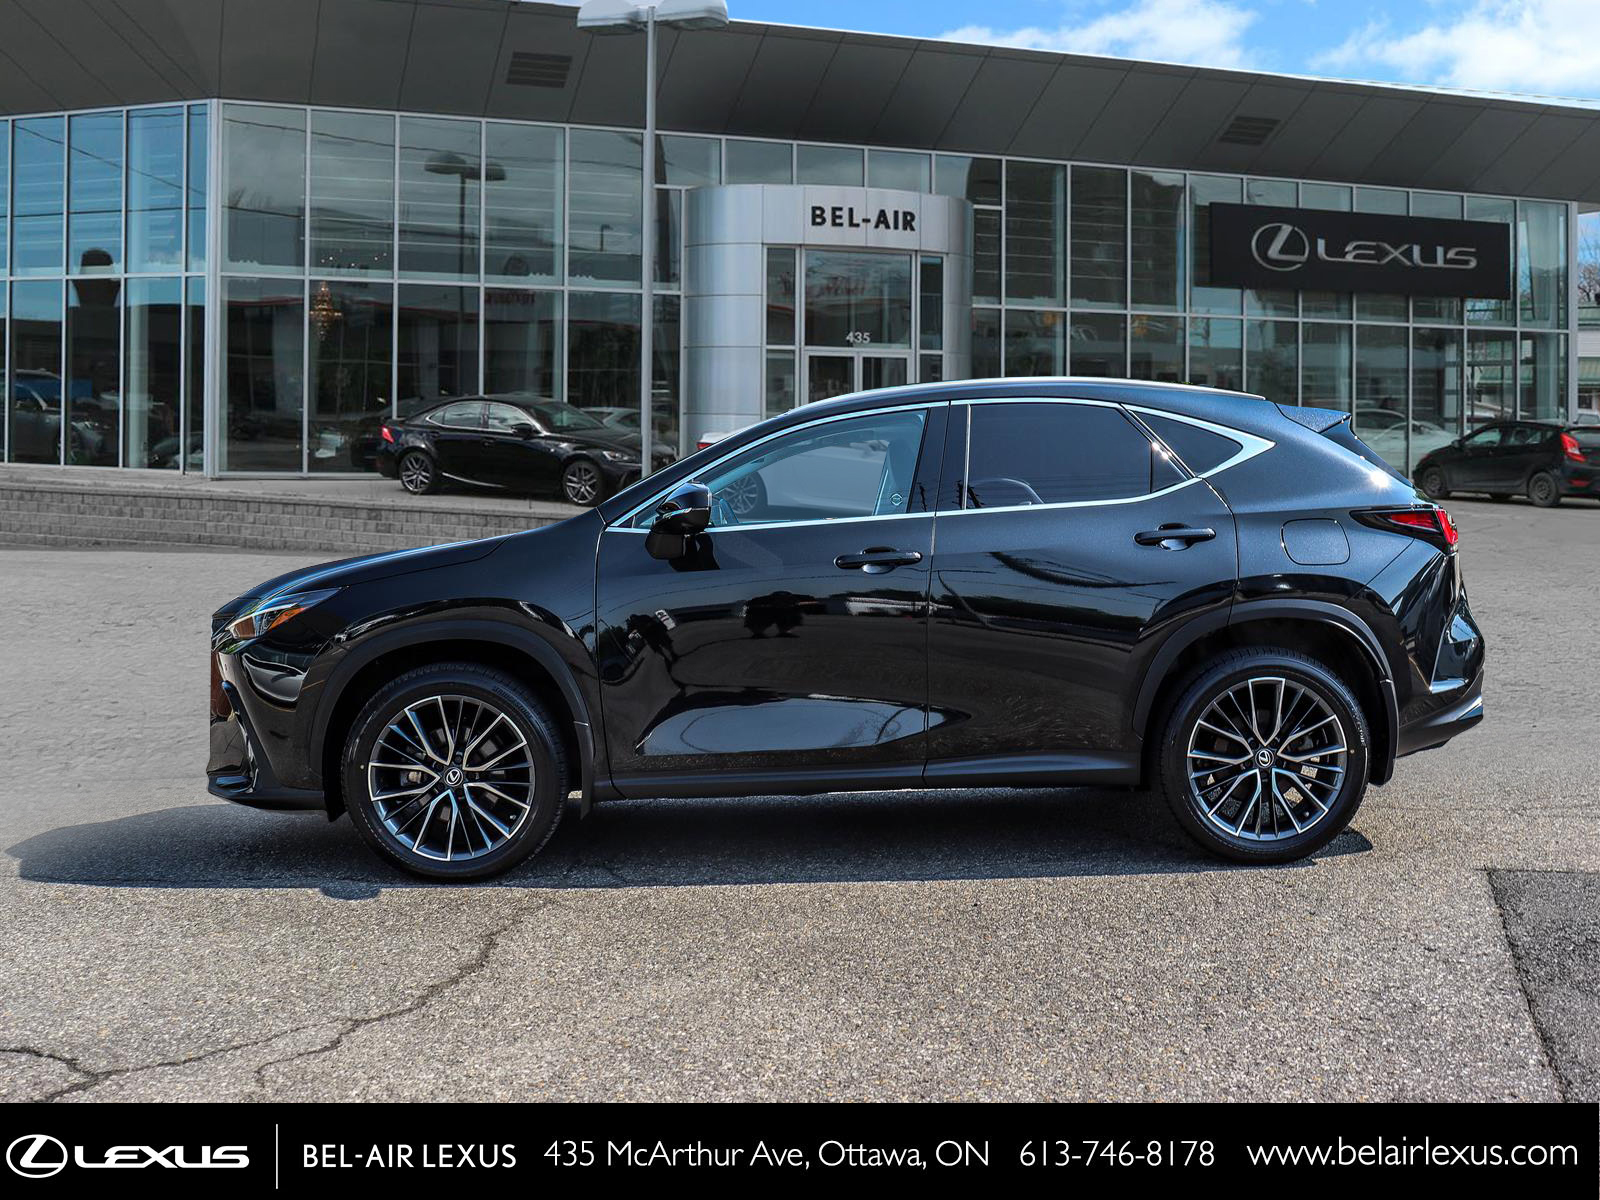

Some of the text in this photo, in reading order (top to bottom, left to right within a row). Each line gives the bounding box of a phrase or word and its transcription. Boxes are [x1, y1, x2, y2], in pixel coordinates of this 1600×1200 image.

[811, 205, 916, 231] BEL-AIR
[1316, 238, 1478, 269] LEXUS
[846, 331, 871, 344] 435
